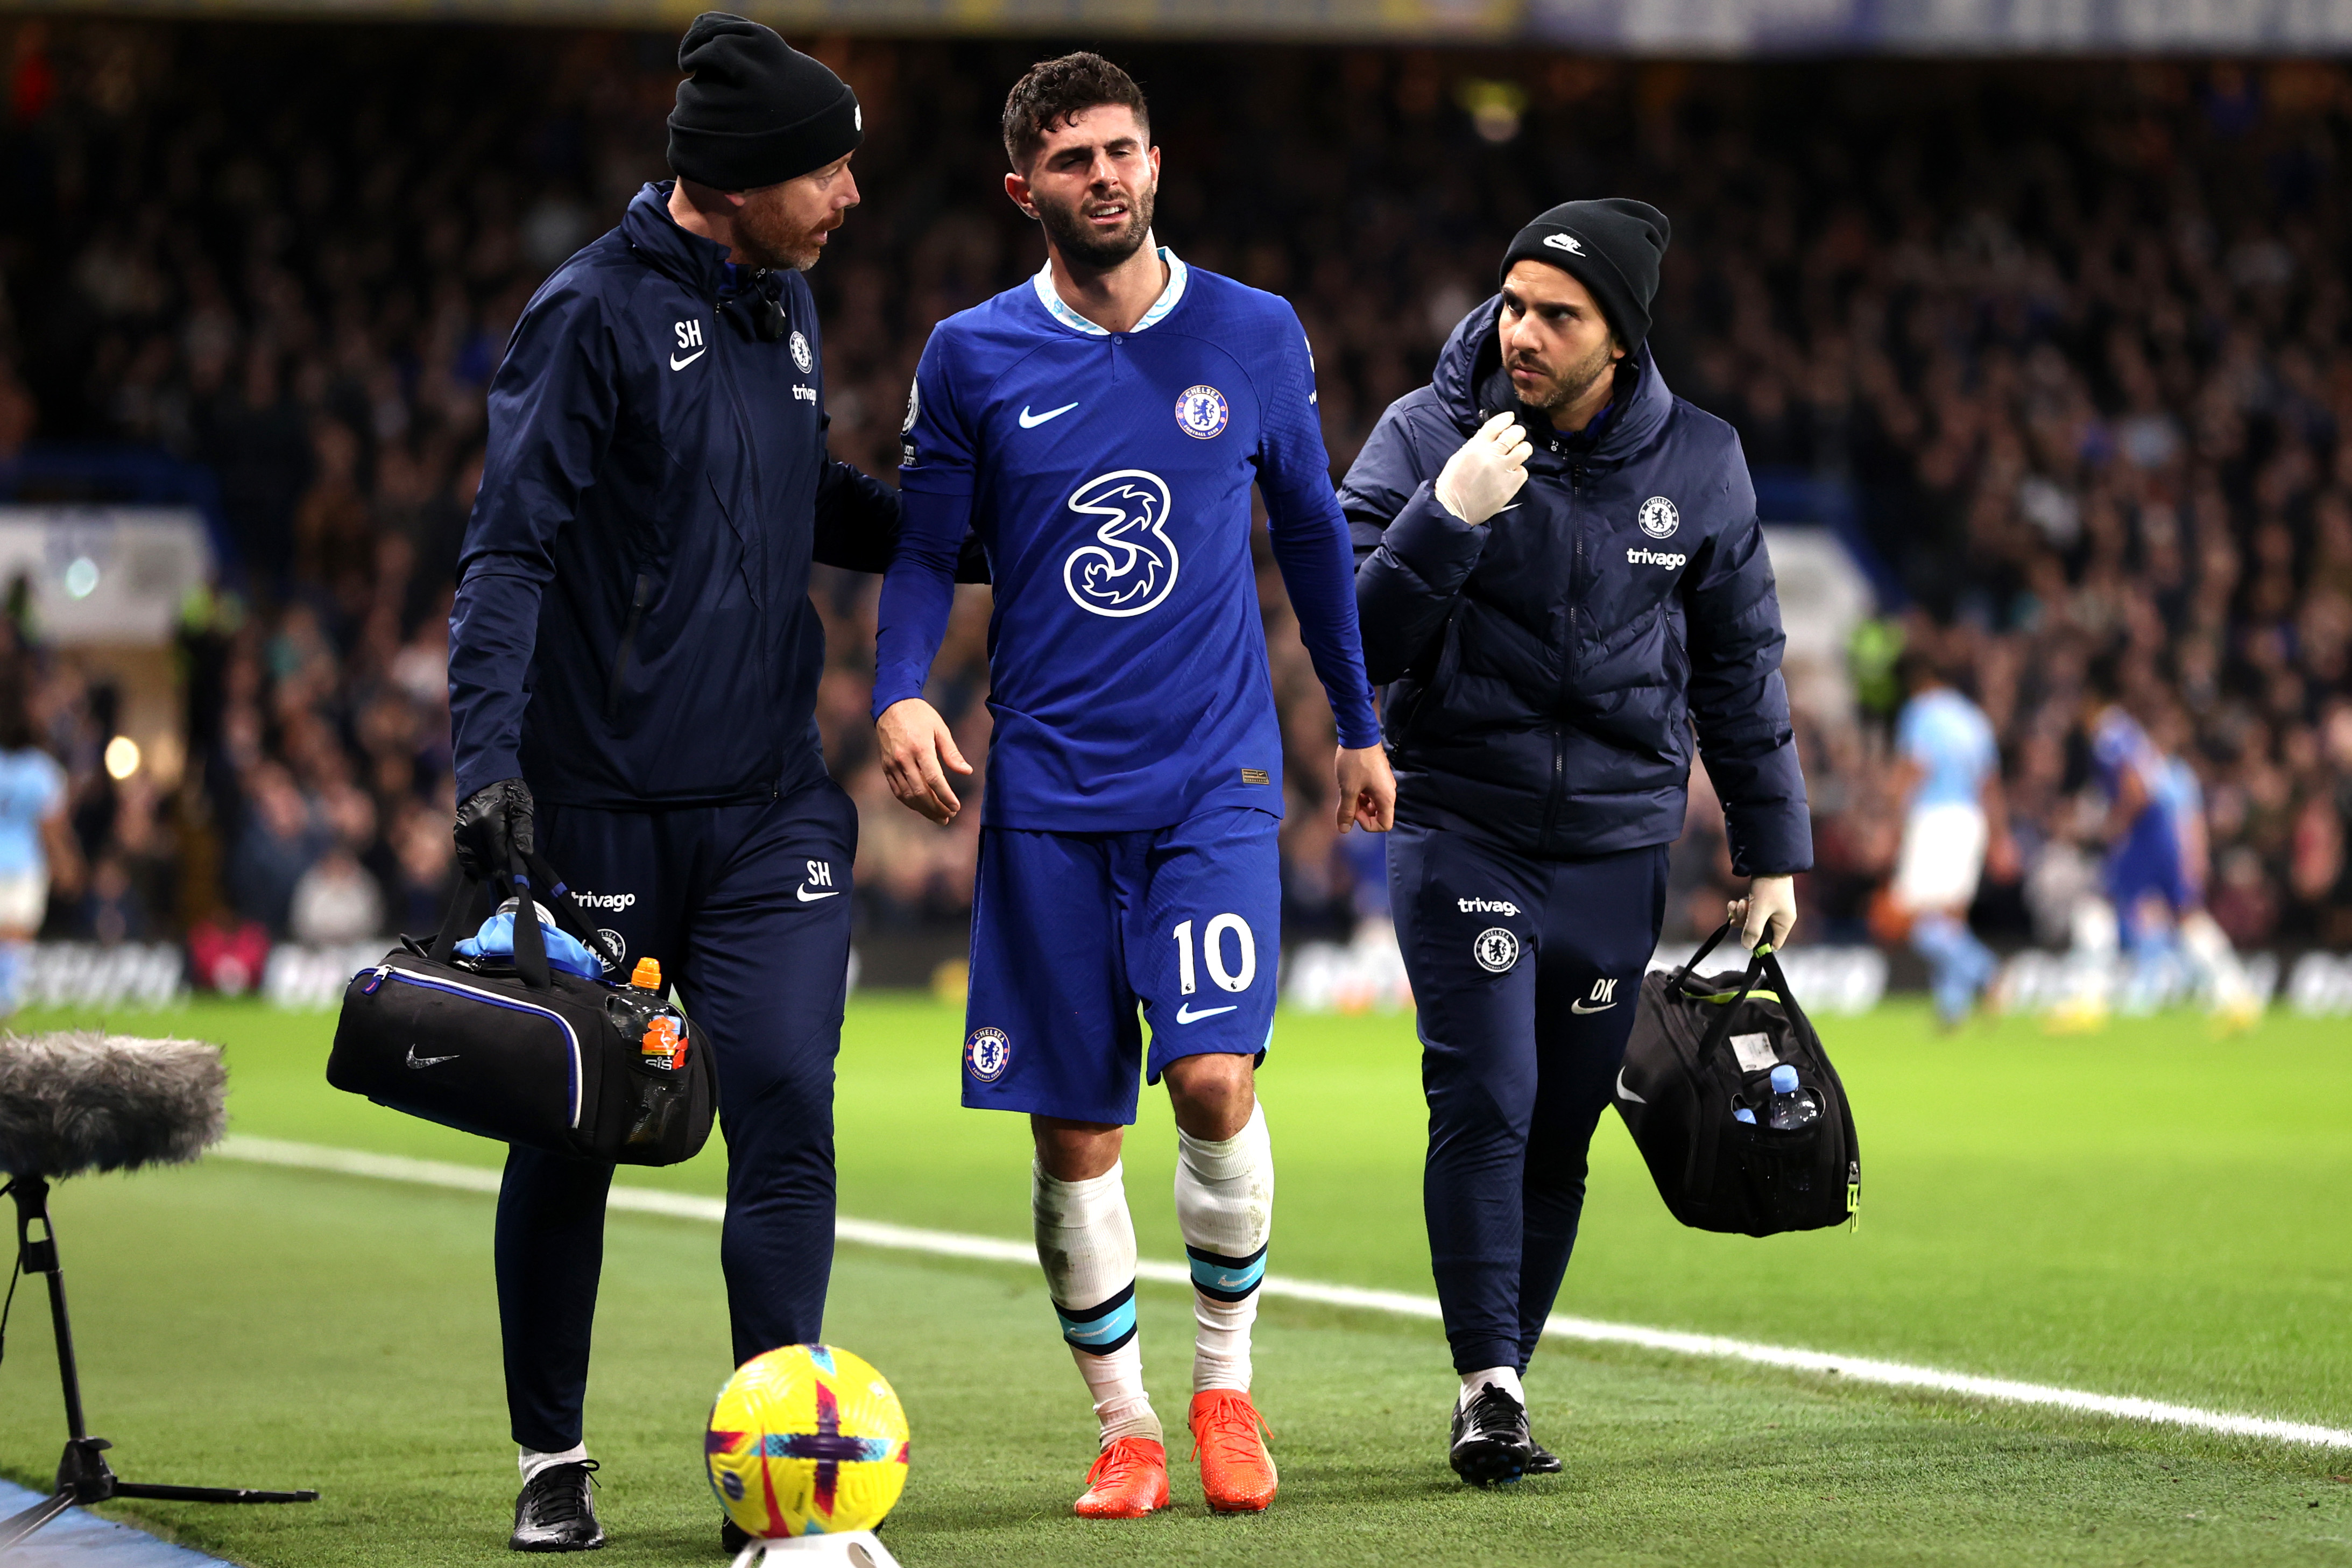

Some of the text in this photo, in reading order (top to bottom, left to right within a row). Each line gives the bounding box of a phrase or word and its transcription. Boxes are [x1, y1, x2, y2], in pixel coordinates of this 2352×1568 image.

[674, 319, 703, 349] SH
[1185, 387, 1220, 401] CHELSEA
[1184, 425, 1219, 436] FOOTBALL CLUB
[1647, 498, 1671, 509] CHELSEA
[1063, 469, 1179, 617] 3
[1626, 547, 1686, 571] trivago
[807, 860, 832, 887] SH
[1482, 930, 1509, 940] CHELSEA
[1173, 913, 1257, 996] 10
[1589, 978, 1618, 1003] DK
[974, 1029, 1005, 1043] CHELSEA
